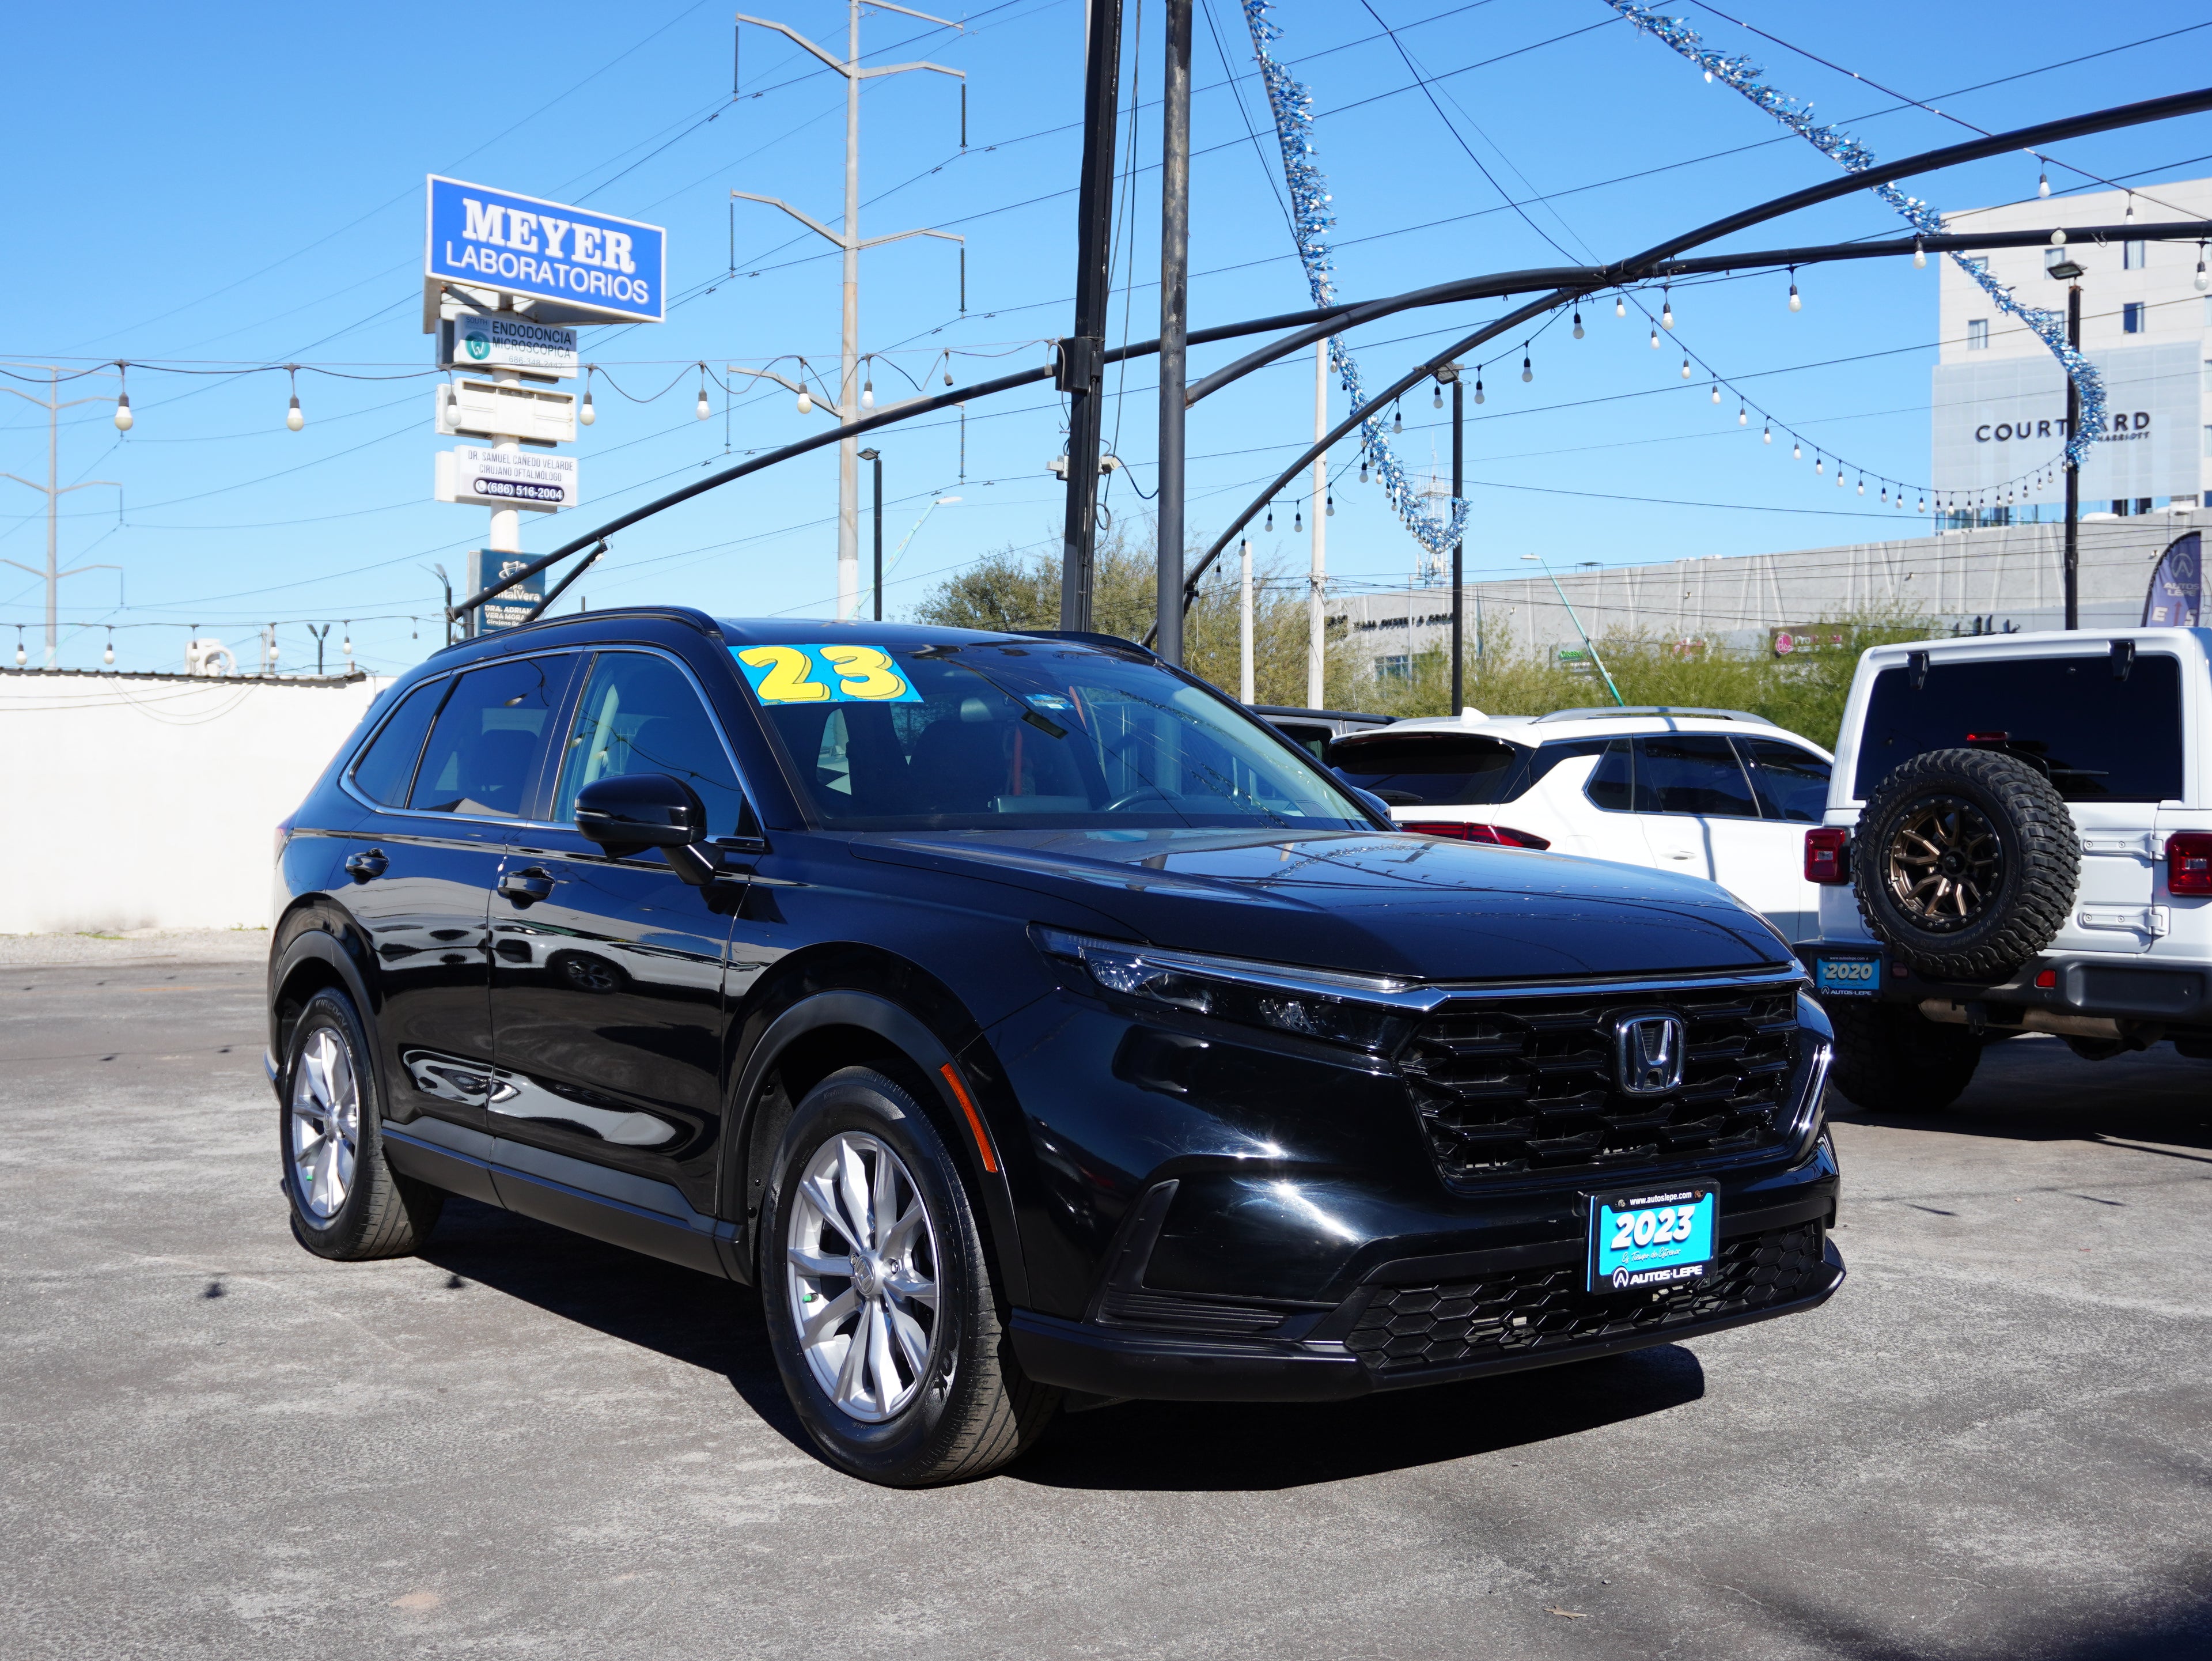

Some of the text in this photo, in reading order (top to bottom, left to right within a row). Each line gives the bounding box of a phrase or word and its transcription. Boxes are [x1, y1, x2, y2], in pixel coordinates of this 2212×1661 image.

[463, 198, 635, 274] MEYER
[446, 240, 649, 304] LABORATORIOS
[492, 321, 571, 345] ENDODONCIA
[492, 336, 571, 360] MICROSCOPICA
[1975, 411, 2150, 442] COURTRD
[468, 450, 573, 471] DR. SAMUEL CAÑEDO VELARDE
[479, 464, 512, 476] CIRUJANO
[487, 482, 562, 500] (686) 516-2004
[503, 606, 532, 614] ADRIAN
[1825, 963, 1873, 979] 2020
[1630, 1191, 1692, 1206] www.autoslepe.com
[1611, 1205, 1695, 1250] 2023
[1658, 1246, 1681, 1259] Estrenar
